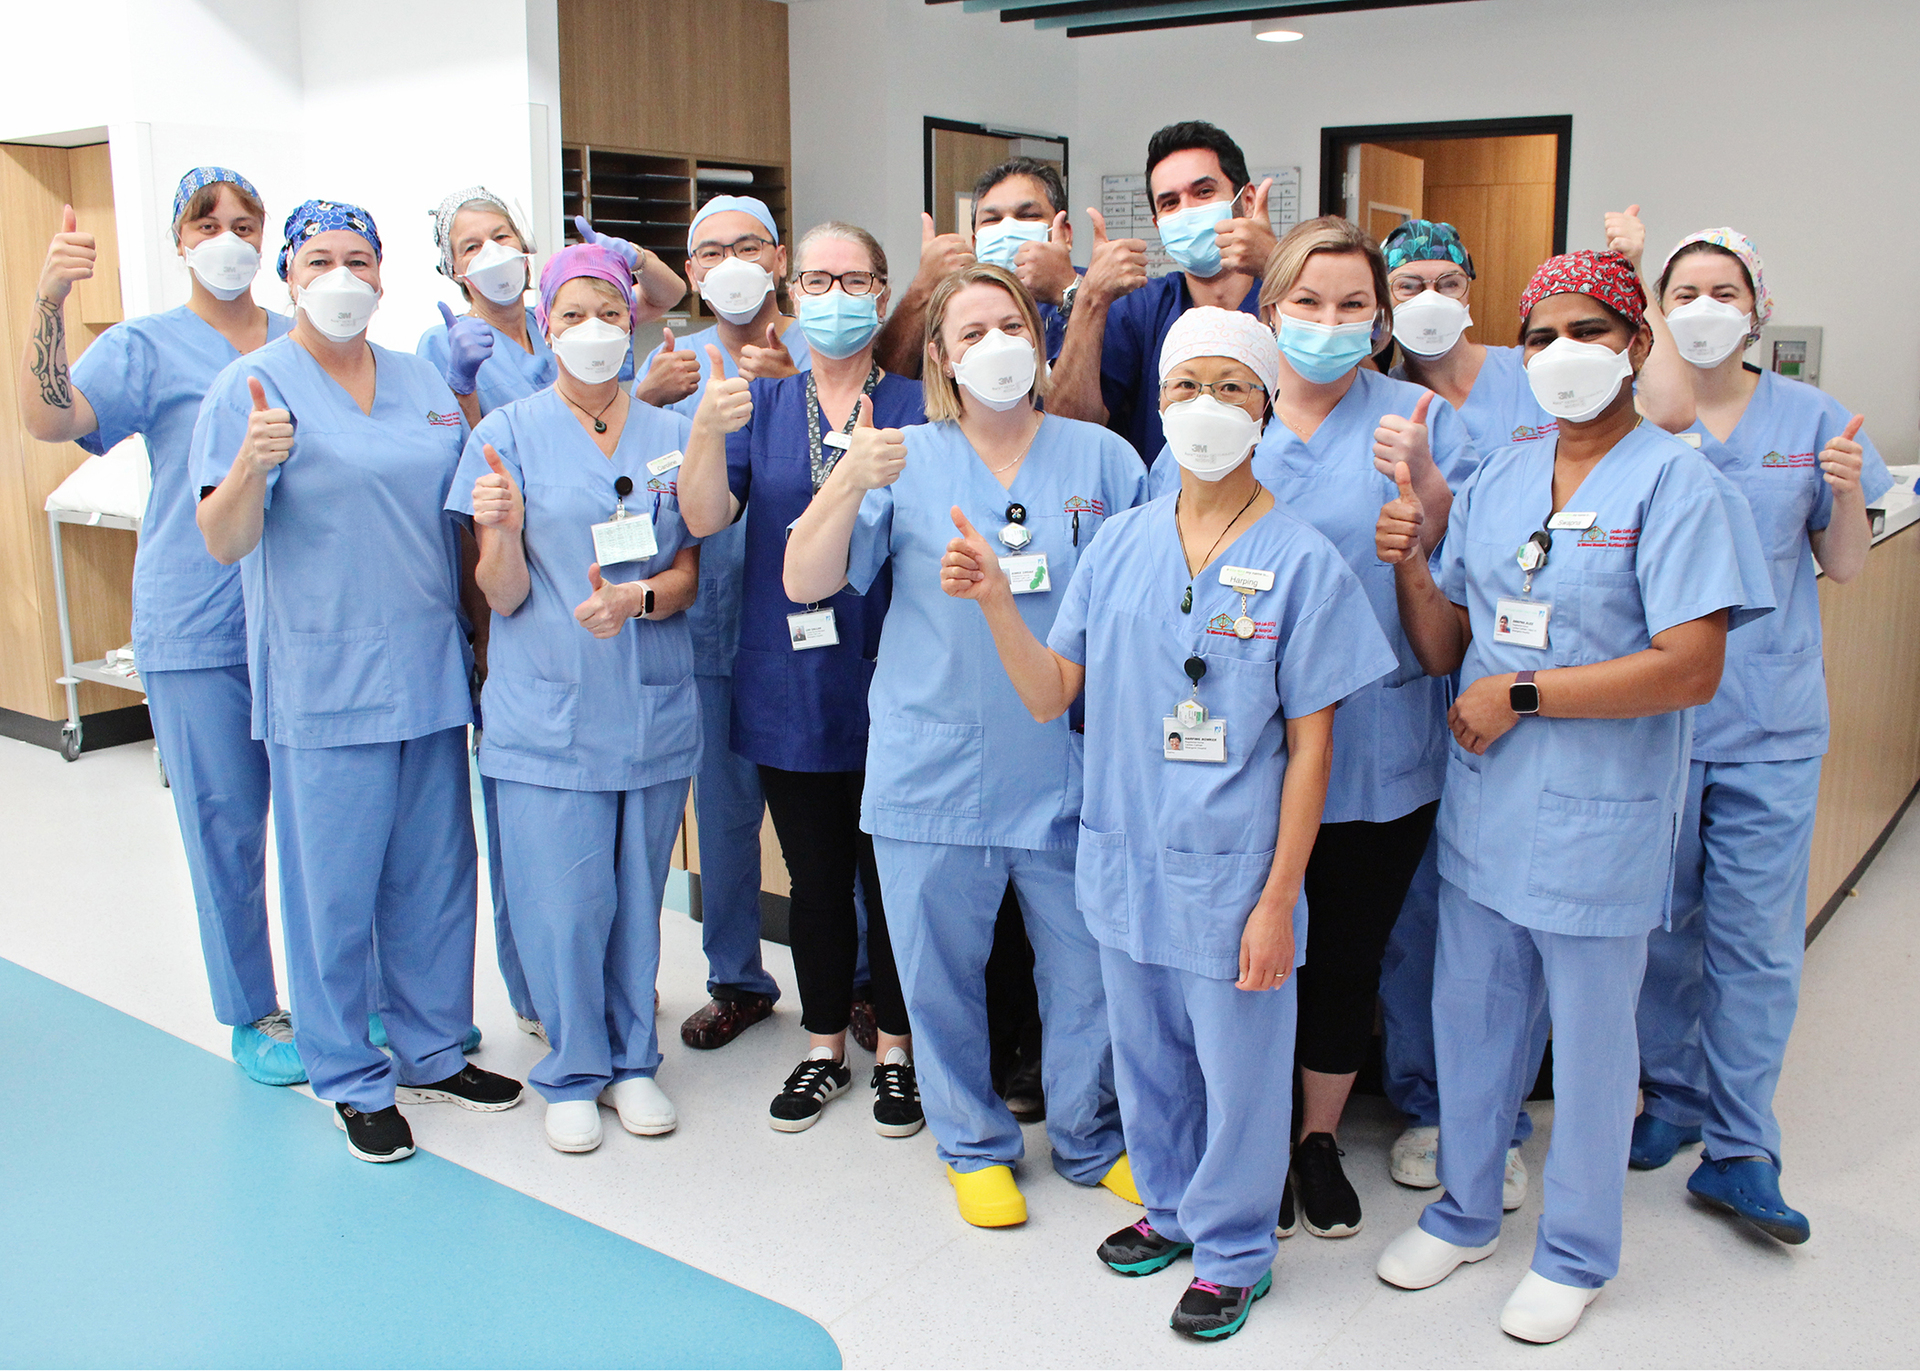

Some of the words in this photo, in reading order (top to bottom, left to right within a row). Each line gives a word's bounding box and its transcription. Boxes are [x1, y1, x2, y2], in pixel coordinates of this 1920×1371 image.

[729, 292, 741, 300] 3M
[338, 311, 352, 319] 3M
[1422, 328, 1437, 336] 3M
[1693, 340, 1707, 348] 3M
[998, 375, 1013, 385] 3M
[1557, 390, 1575, 400] 3M
[1191, 444, 1208, 453] 3M
[1229, 576, 1259, 587] Harping
